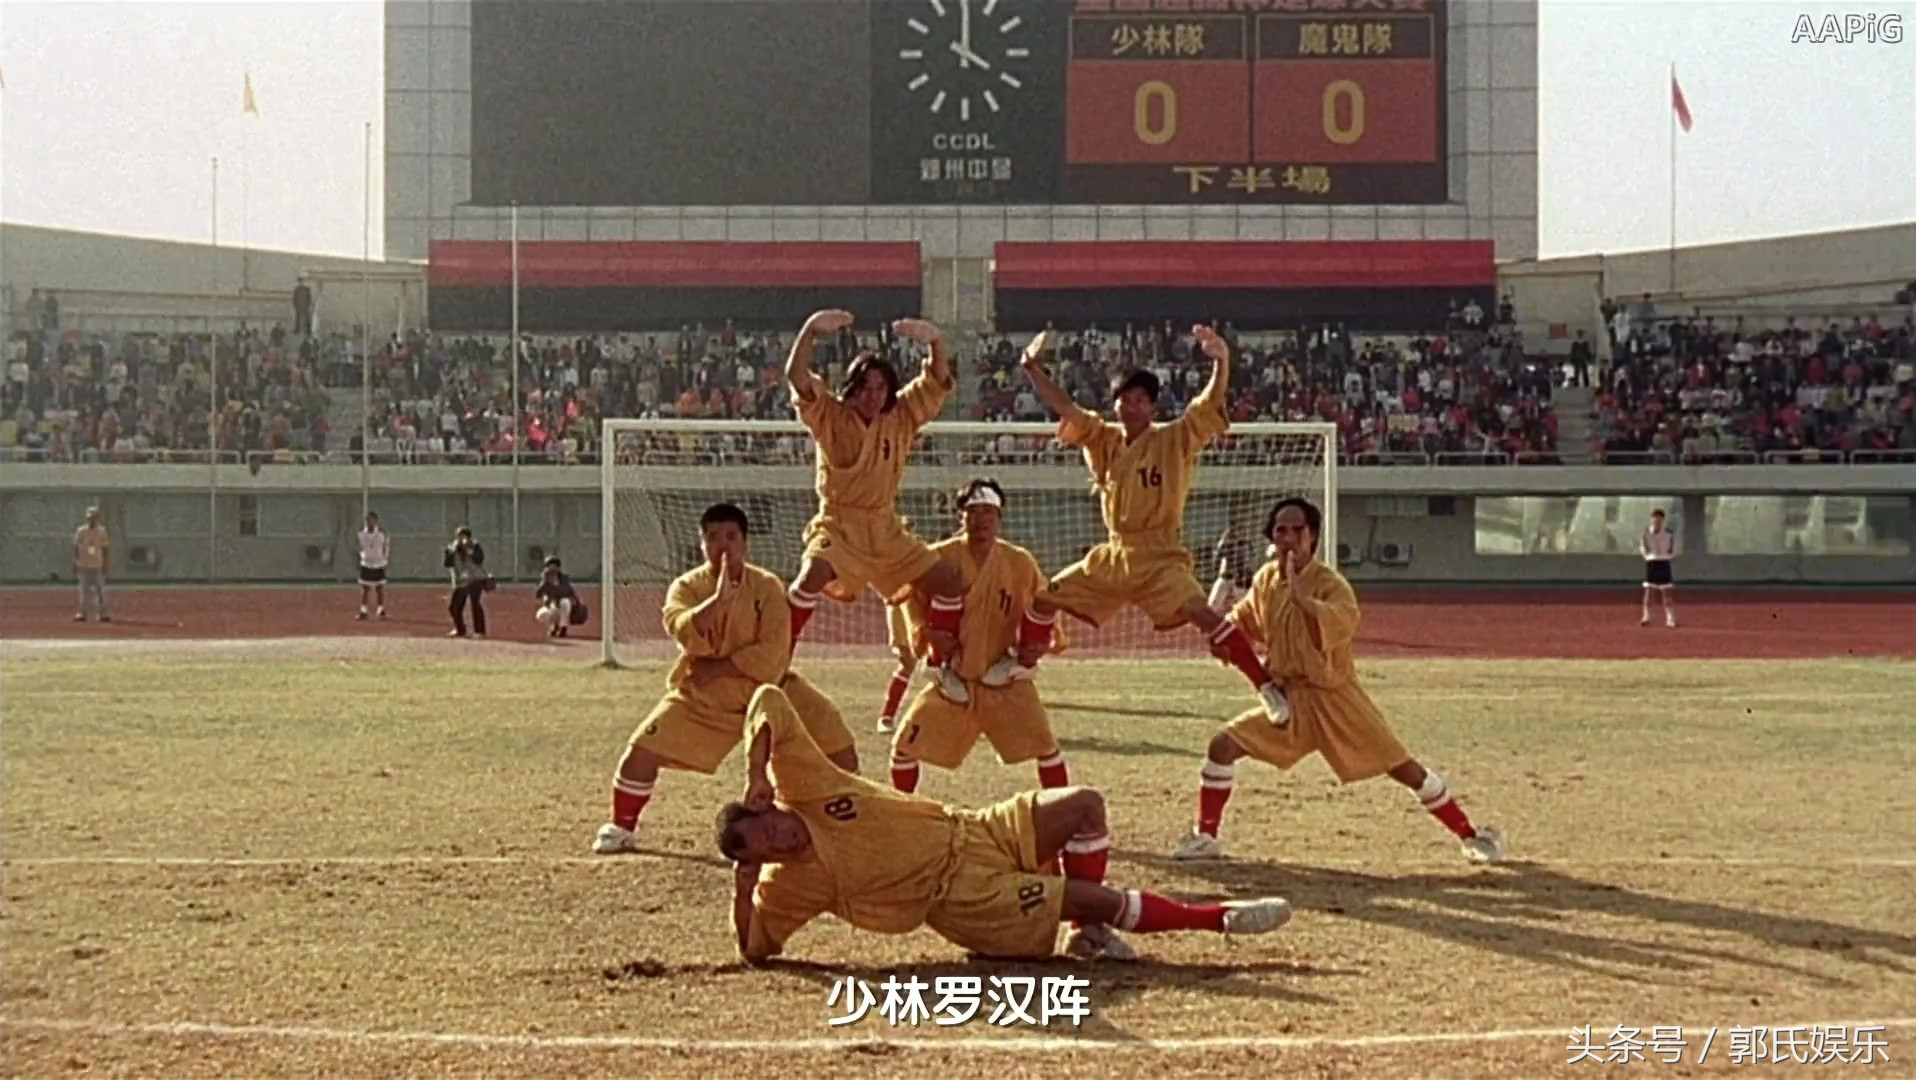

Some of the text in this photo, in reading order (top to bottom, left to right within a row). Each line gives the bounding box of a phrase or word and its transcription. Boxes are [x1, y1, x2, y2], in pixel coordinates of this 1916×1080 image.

[1111, 23, 1205, 57] 少林隊
[1299, 22, 1393, 55] 魔鬼隊
[1134, 80, 1178, 144] 0
[1322, 80, 1365, 144] 0
[932, 132, 996, 150] CCDL
[1172, 165, 1332, 194] 下半場
[1137, 466, 1162, 489] 16
[824, 795, 858, 822] 18
[1018, 880, 1047, 917] 18
